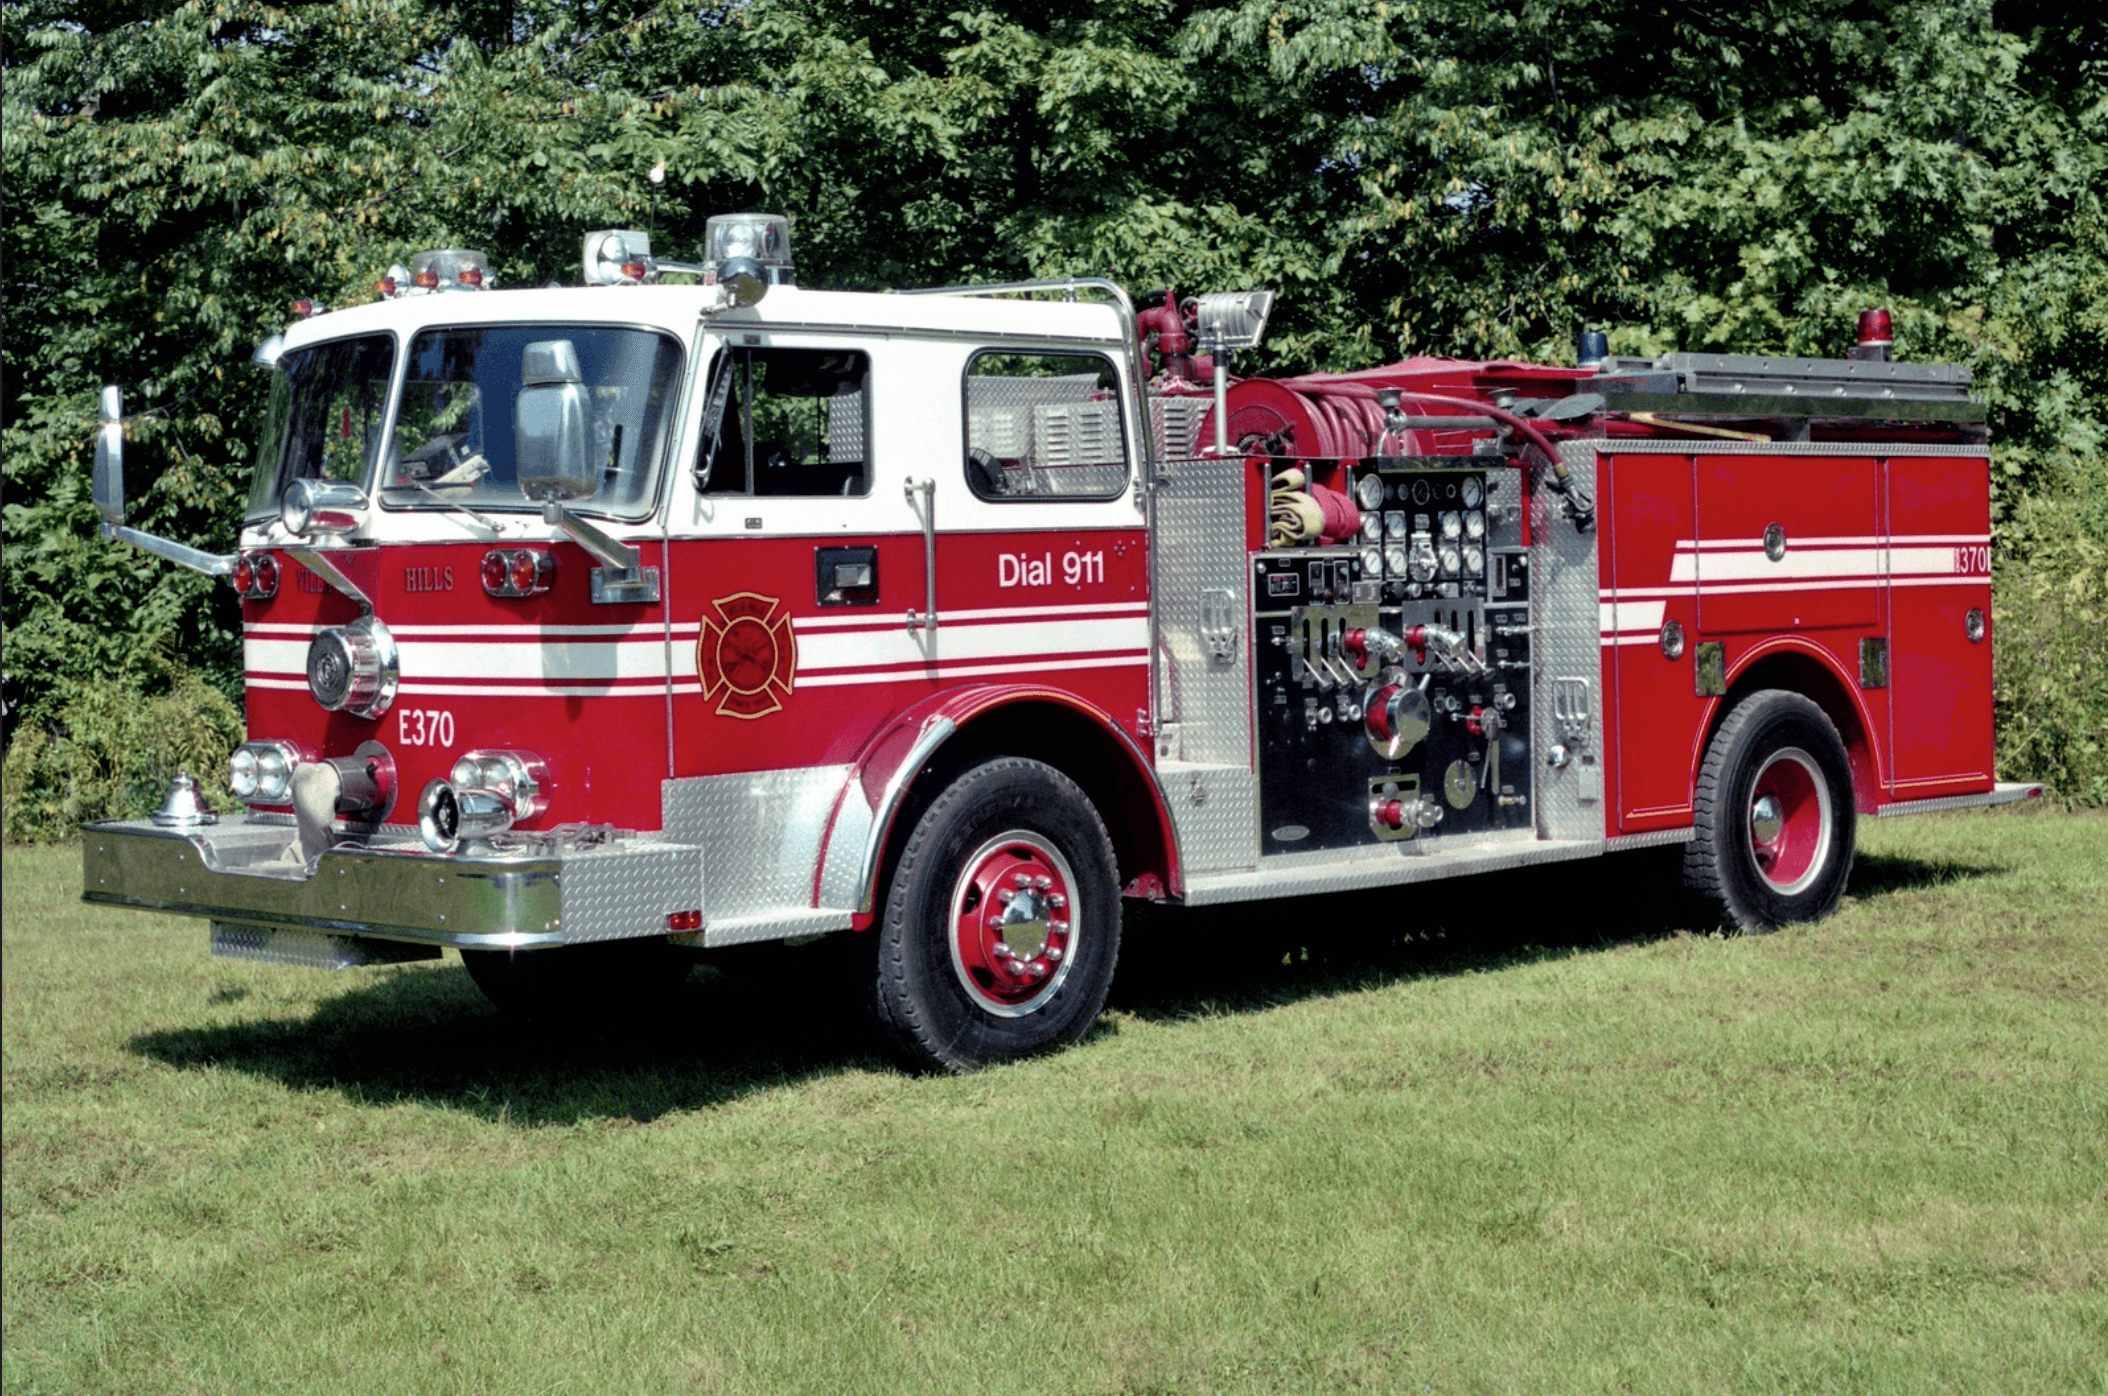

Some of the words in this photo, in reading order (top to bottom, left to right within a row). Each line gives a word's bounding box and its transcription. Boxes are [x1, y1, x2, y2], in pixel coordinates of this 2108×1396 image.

[999, 552, 1052, 588] Dial
[1062, 550, 1104, 585] 911
[1960, 546, 1986, 573] 370
[405, 566, 454, 592] HILLS
[399, 708, 455, 748] E370
